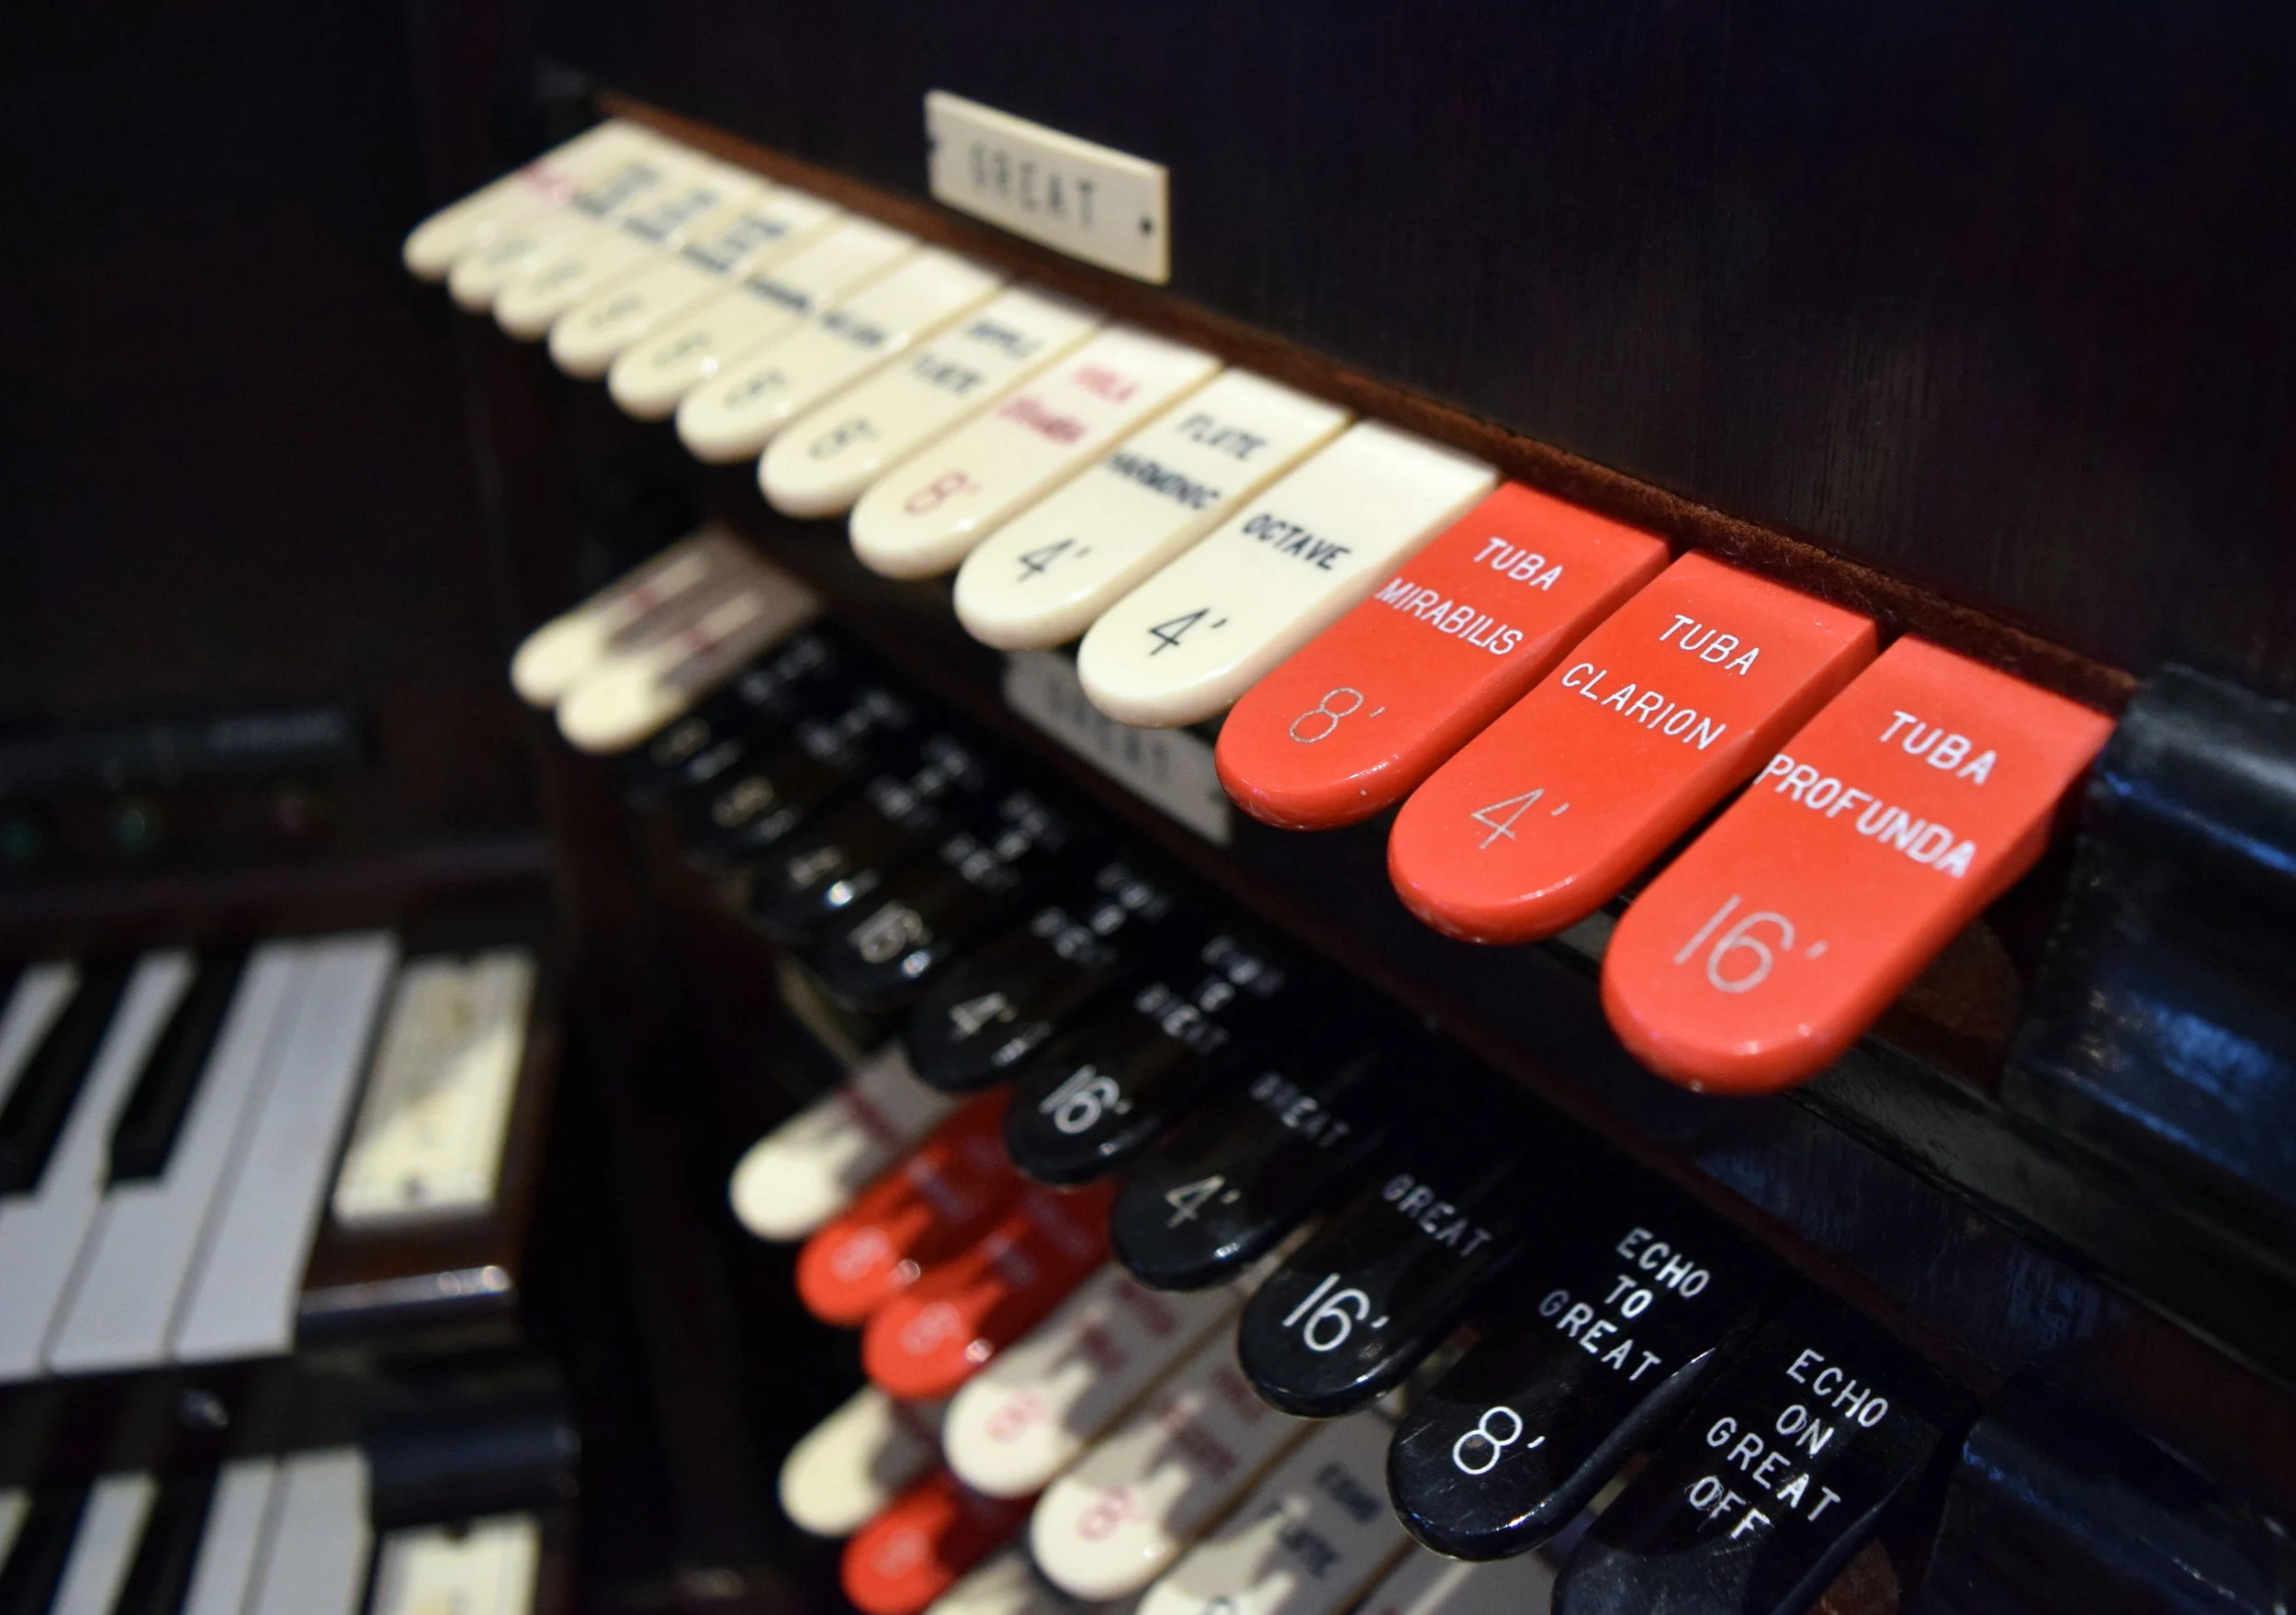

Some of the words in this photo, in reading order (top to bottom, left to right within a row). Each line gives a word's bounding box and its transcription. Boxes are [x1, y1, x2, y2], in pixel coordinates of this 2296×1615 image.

[1016, 537, 1091, 583] 4'
[1242, 513, 1351, 571] OCTAVE
[1473, 537, 1564, 591] TUBA
[1148, 607, 1228, 656] 4'
[1374, 578, 1525, 656] MIRABILIS
[1659, 613, 1761, 677] TUBA
[1289, 687, 1385, 745] 8'
[1561, 662, 1727, 751] CLARION
[1879, 710, 1998, 786] TUBA
[1469, 788, 1570, 849] 4'
[1753, 753, 1978, 879] PROFUNDA
[1672, 894, 1829, 993] 16'
[1165, 1174, 1241, 1228] 4'
[1381, 1172, 1492, 1257] GREAT
[1604, 1275, 1653, 1319] TO
[1616, 1227, 1710, 1299] ECHO
[1282, 1273, 1390, 1352] 16'
[1538, 1290, 1661, 1381] GREAT
[1785, 1348, 1888, 1429] ECHO
[1453, 1407, 1545, 1475] 8'
[1775, 1404, 1834, 1458] ON
[1706, 1417, 1841, 1521] GREAT
[1688, 1475, 1772, 1540] OFF
